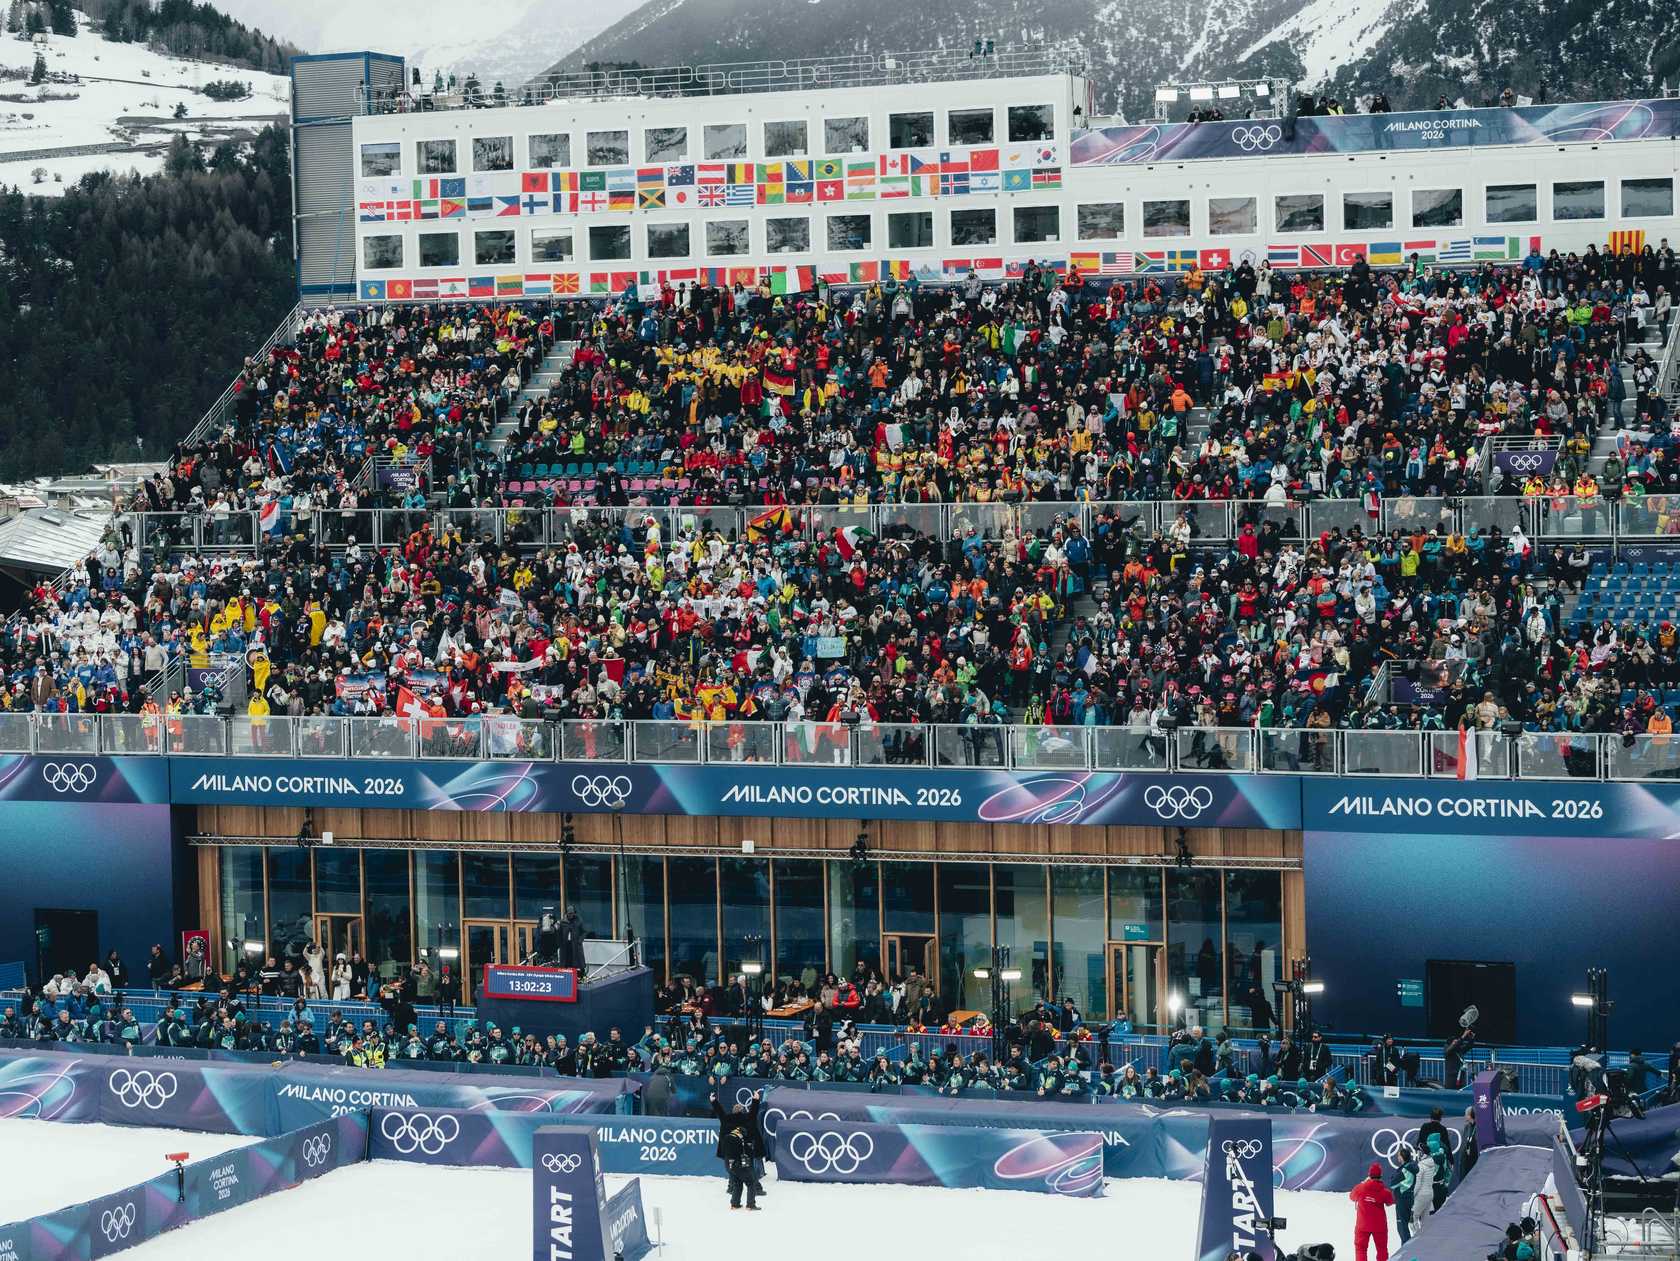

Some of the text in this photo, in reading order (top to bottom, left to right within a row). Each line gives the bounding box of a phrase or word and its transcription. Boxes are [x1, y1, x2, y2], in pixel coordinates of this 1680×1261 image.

[1384, 118, 1483, 132] MILANO CORTINA
[1421, 130, 1445, 140] 2026
[191, 774, 405, 795] MILANO CORTINA 2026
[720, 784, 962, 807] MILANO CORTINA 2026
[1328, 796, 1604, 820] MILANO CORTINA 2026
[509, 980, 552, 993] 13:02:23
[277, 1083, 419, 1108] MILANO CORTINA
[660, 1129, 720, 1145] CORTIN
[639, 1145, 678, 1161] 2026
[209, 1163, 235, 1181] MILANO
[213, 1174, 240, 1191] CORTINA
[550, 1184, 573, 1261] TART
[1232, 1178, 1256, 1261] TART
